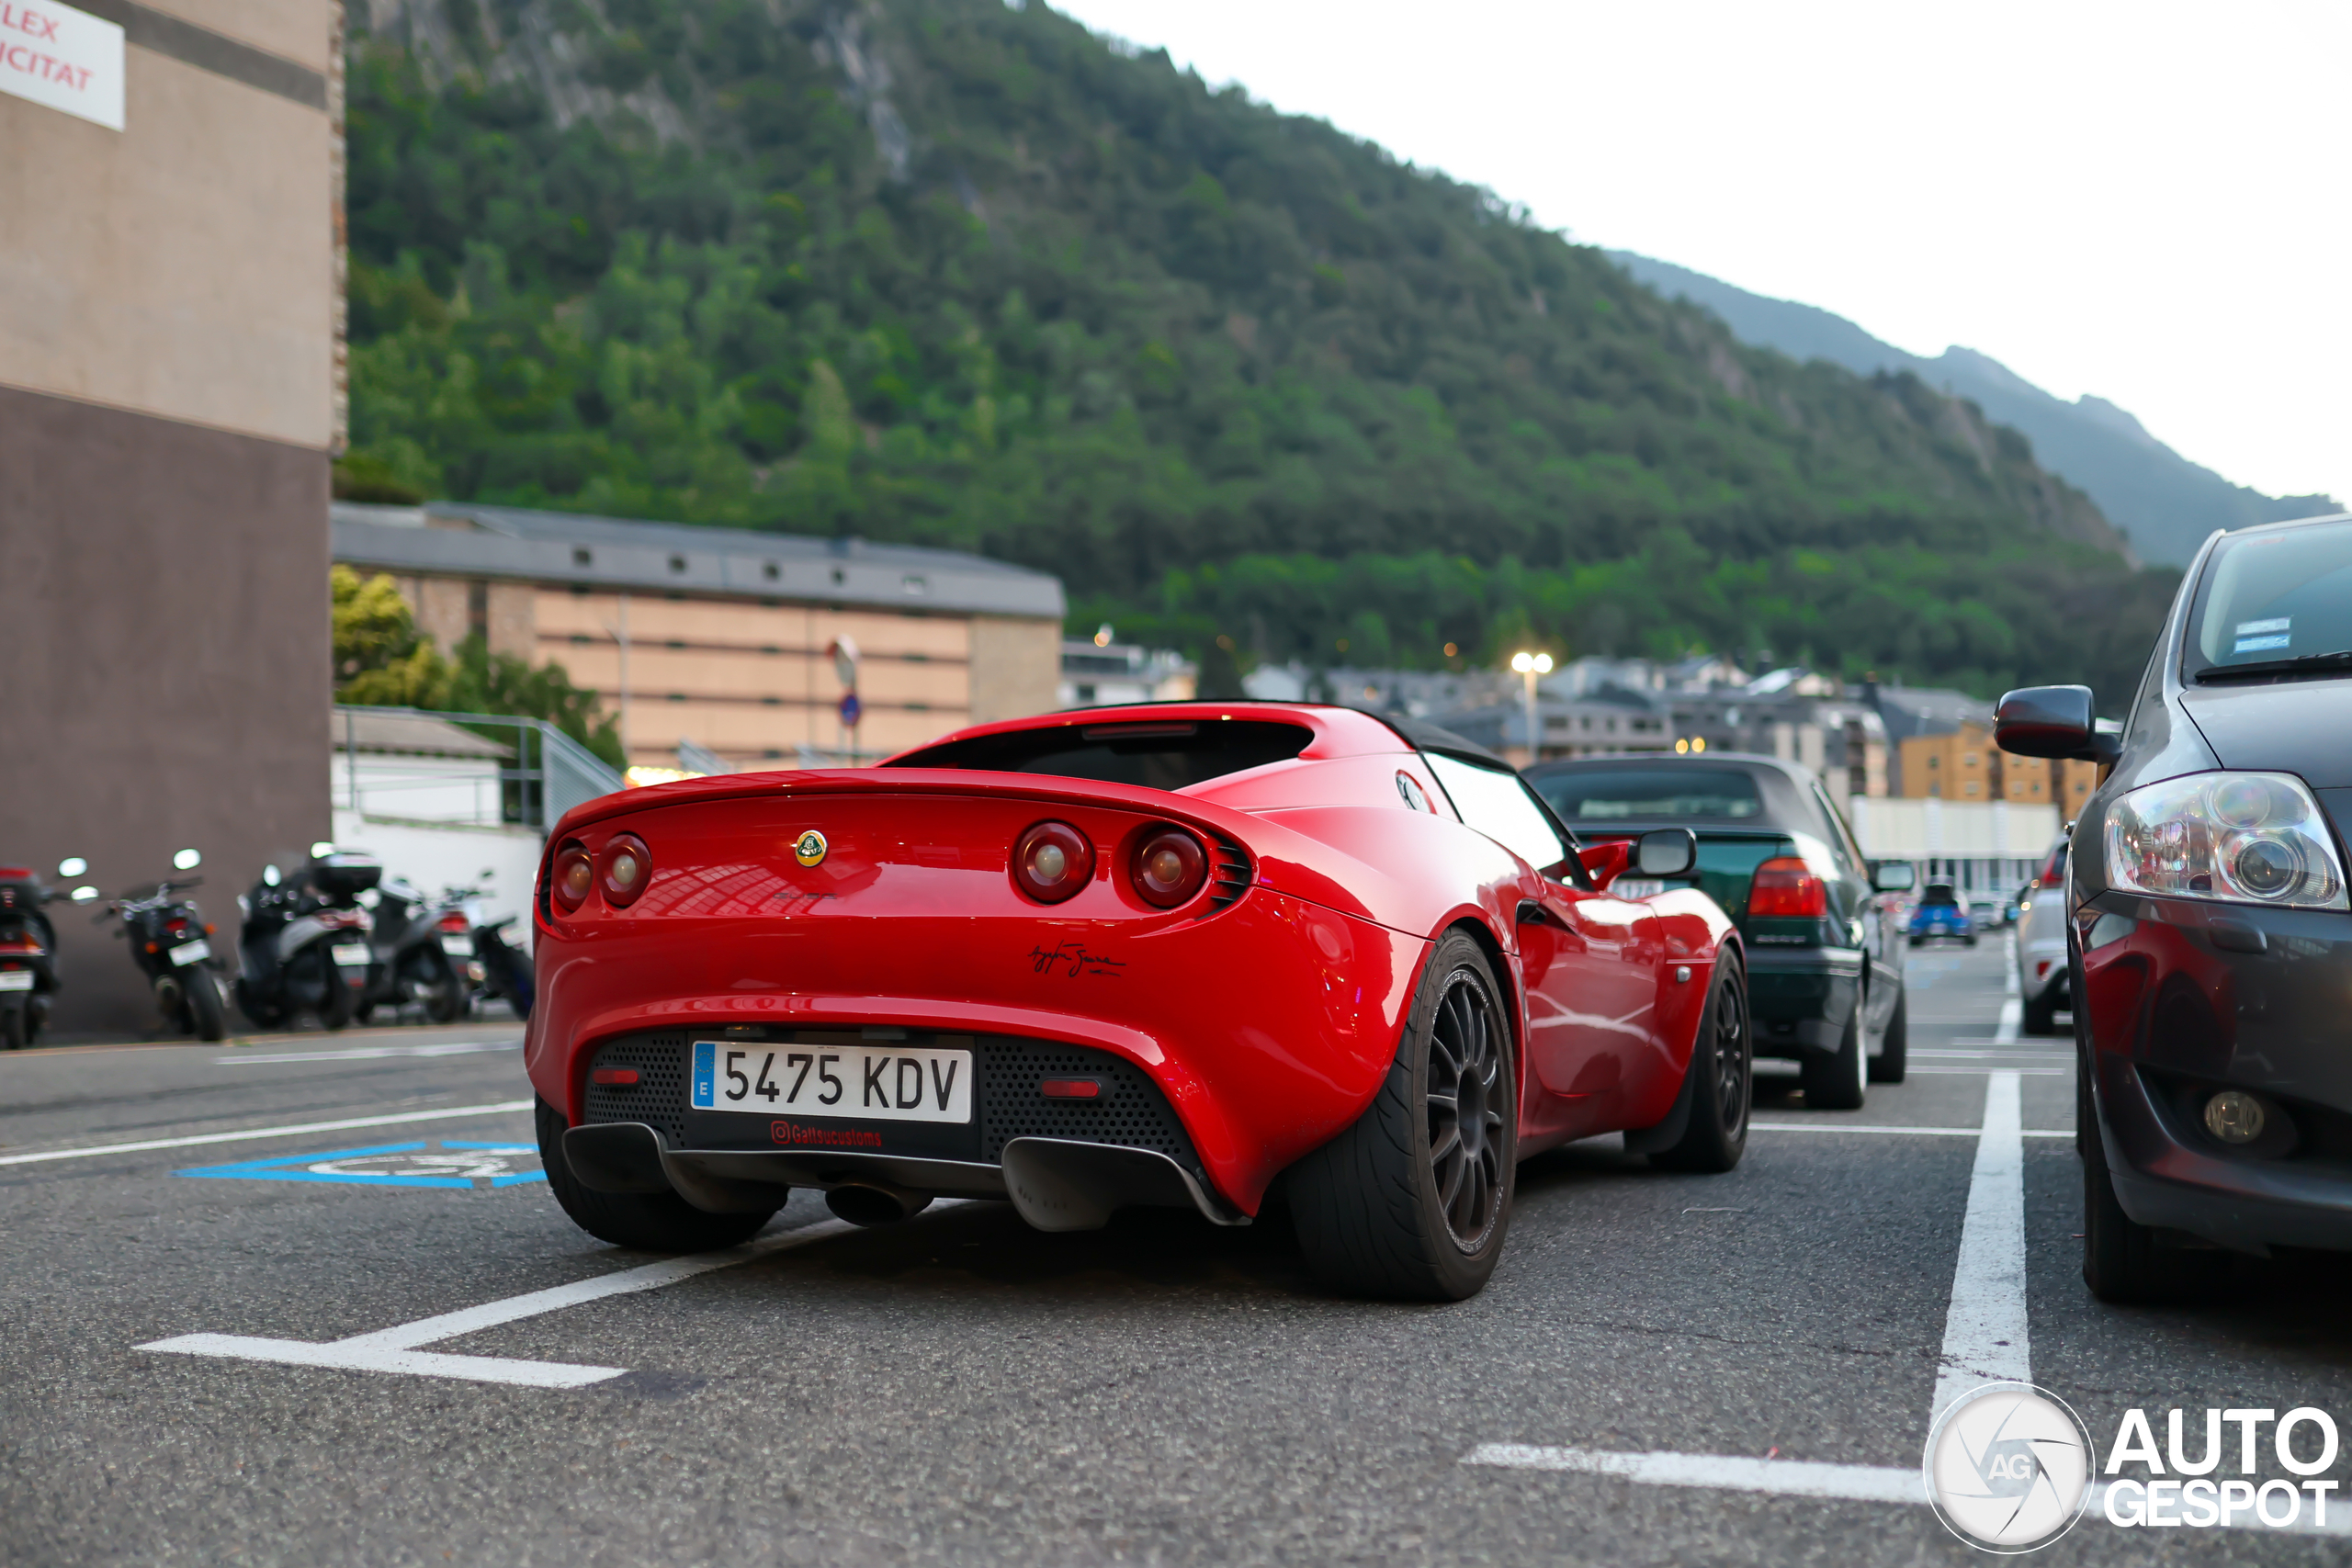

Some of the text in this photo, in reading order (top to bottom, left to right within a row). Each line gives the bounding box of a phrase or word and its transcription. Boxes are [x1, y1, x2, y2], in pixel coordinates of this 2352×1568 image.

[699, 1051, 958, 1111] E 5475 KDV
[792, 1124, 882, 1147] Gattsucustoms
